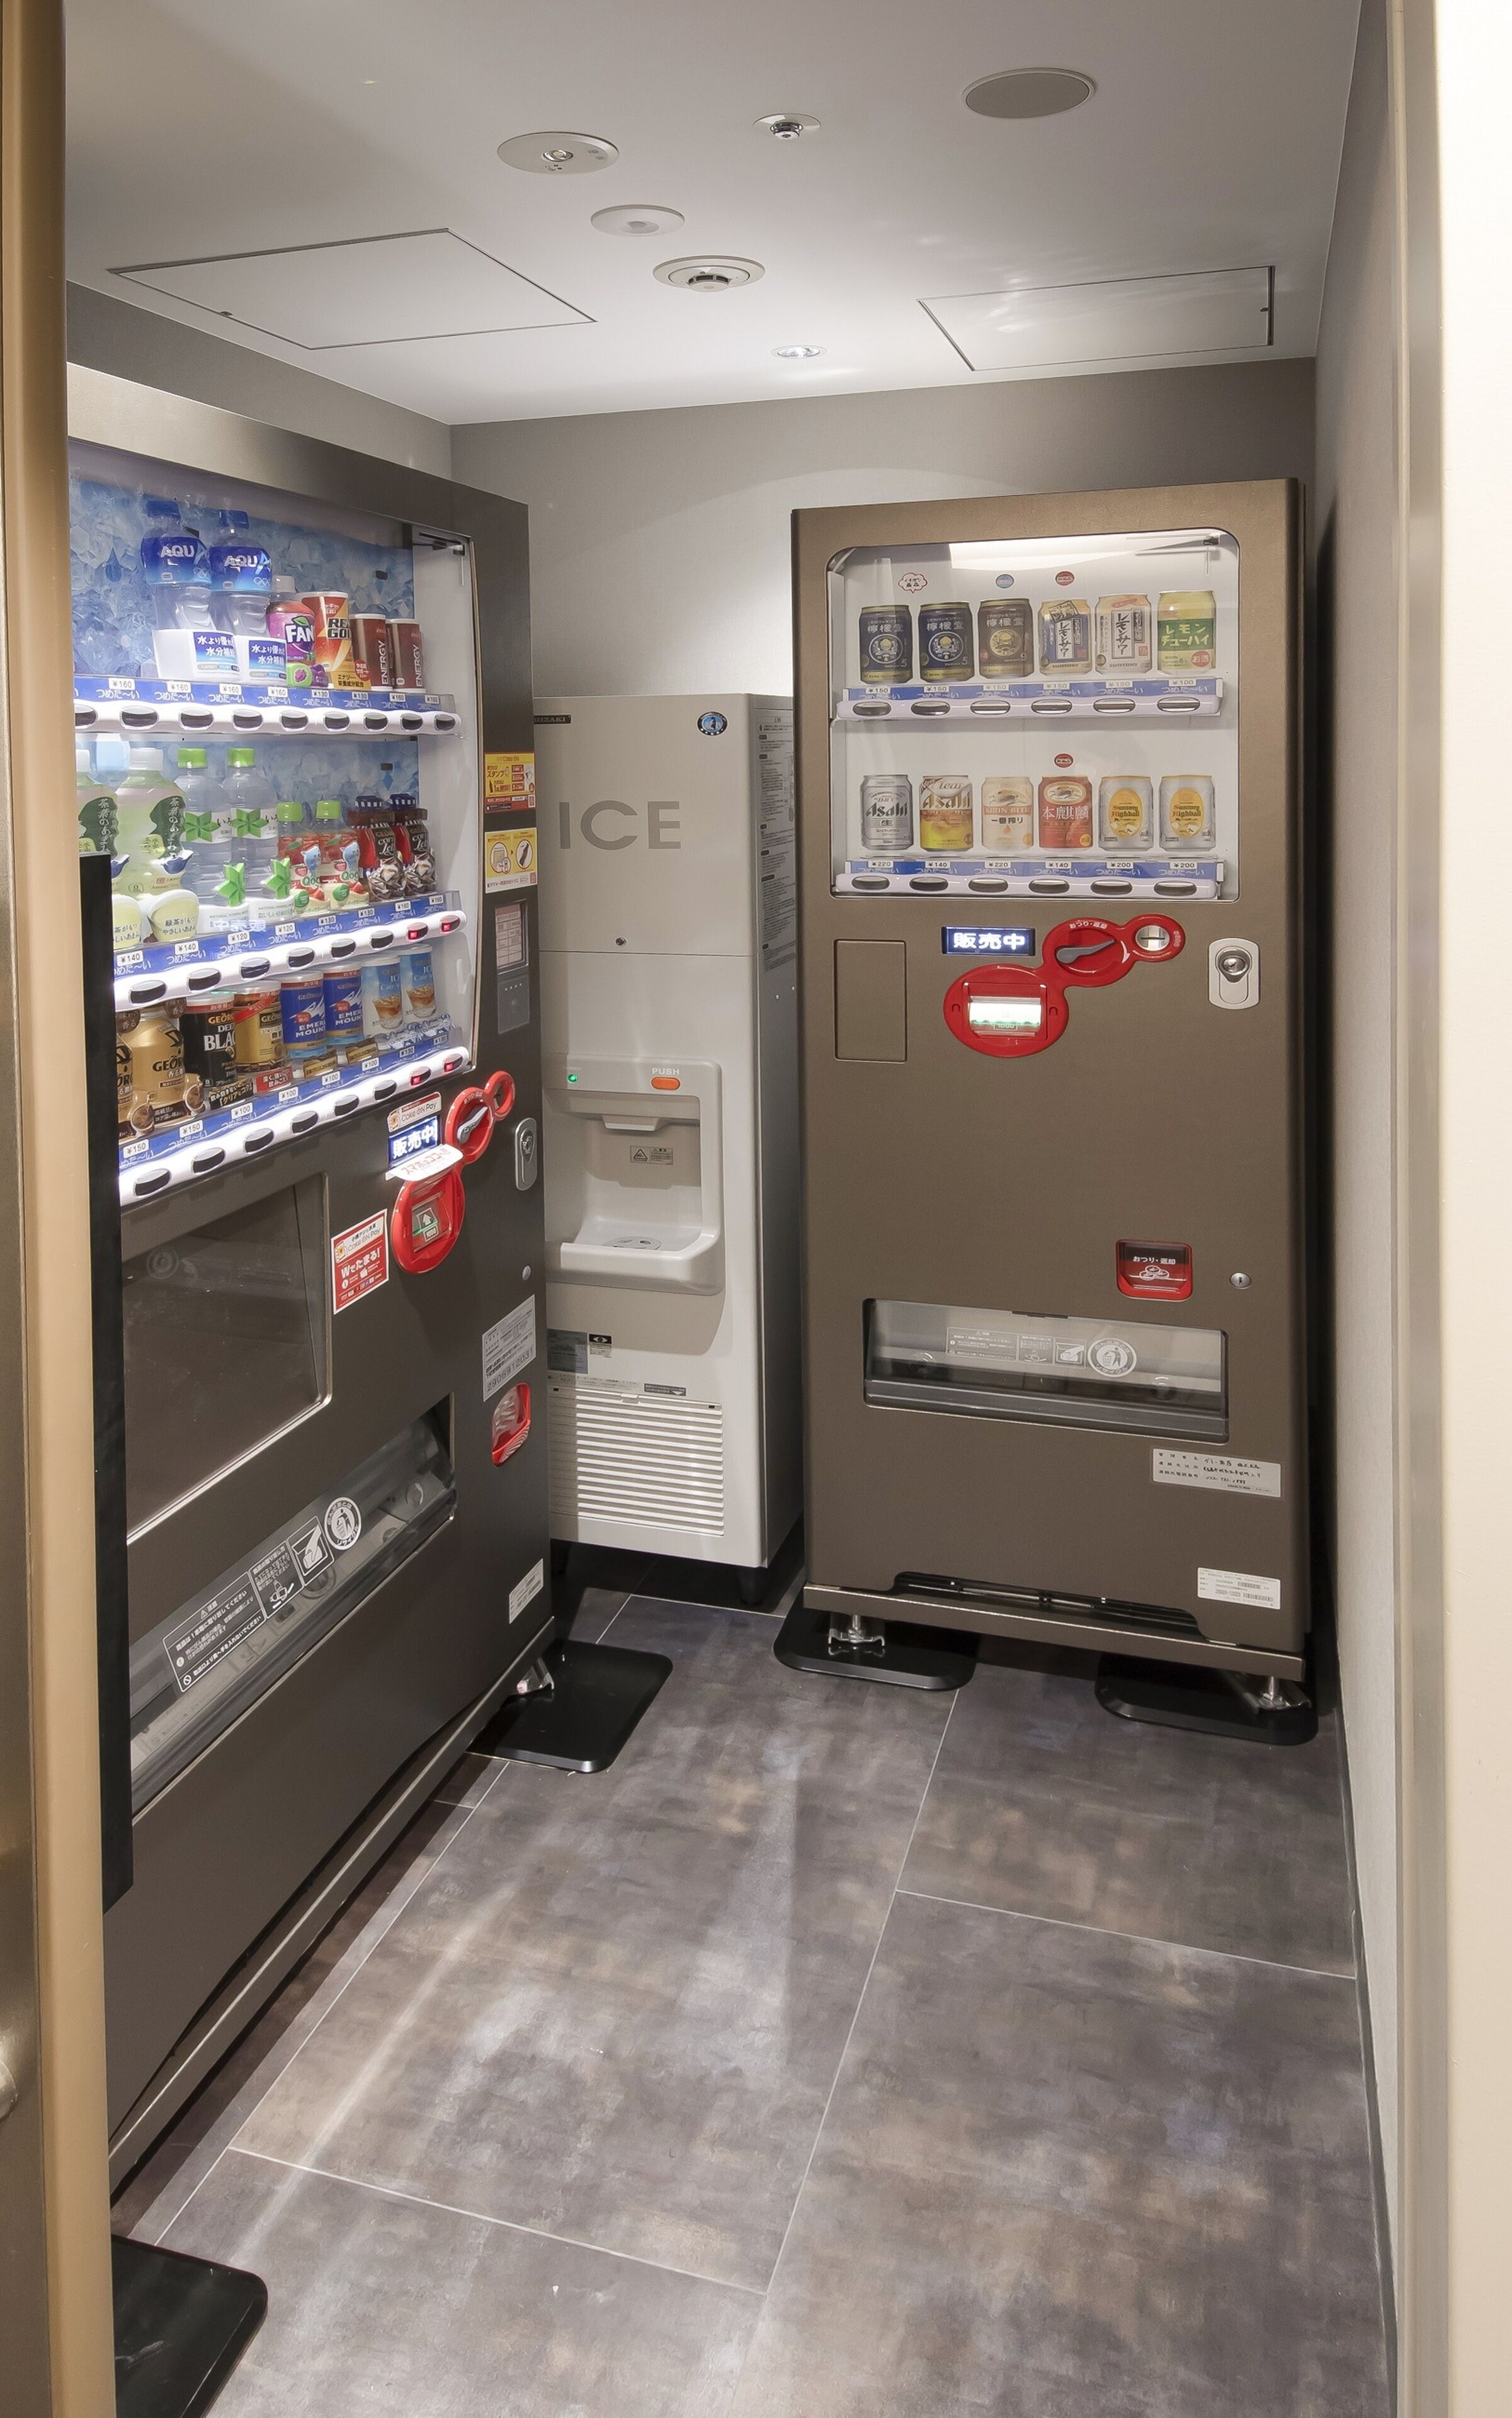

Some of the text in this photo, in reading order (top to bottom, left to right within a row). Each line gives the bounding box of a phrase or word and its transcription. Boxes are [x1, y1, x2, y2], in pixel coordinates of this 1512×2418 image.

[926, 621, 964, 631] 檸檬堂
[986, 617, 1024, 627] 檸檬堂
[1166, 623, 1206, 635] レモン
[1161, 634, 1209, 647] チューハイ
[378, 640, 389, 685] ENERGY
[412, 644, 423, 687] ENERGY
[113, 680, 132, 688] ¥160
[923, 790, 971, 809] Asahi
[866, 802, 908, 817] Asahi
[1042, 805, 1089, 820] 本麒麟
[559, 800, 681, 850] ICE
[231, 933, 247, 941] ¥120
[953, 932, 1025, 951] 販売中
[178, 943, 196, 951] ¥140
[120, 954, 140, 963] ¥140
[364, 1060, 378, 1069] ¥100
[652, 1067, 679, 1076] PUSH
[324, 1074, 338, 1082] ¥100
[280, 1090, 297, 1099] ¥100
[234, 1106, 251, 1116] ¥100
[401, 1111, 416, 1122] Coke
[416, 1106, 426, 1115] ON
[426, 1102, 437, 1111] Pay
[183, 1123, 200, 1134] ¥150
[393, 1125, 435, 1159] 販売中
[127, 1142, 146, 1154] ¥150
[348, 1240, 361, 1251] Coke
[370, 1229, 380, 1237] Pay
[1133, 1256, 1176, 1265] おつり・返却
